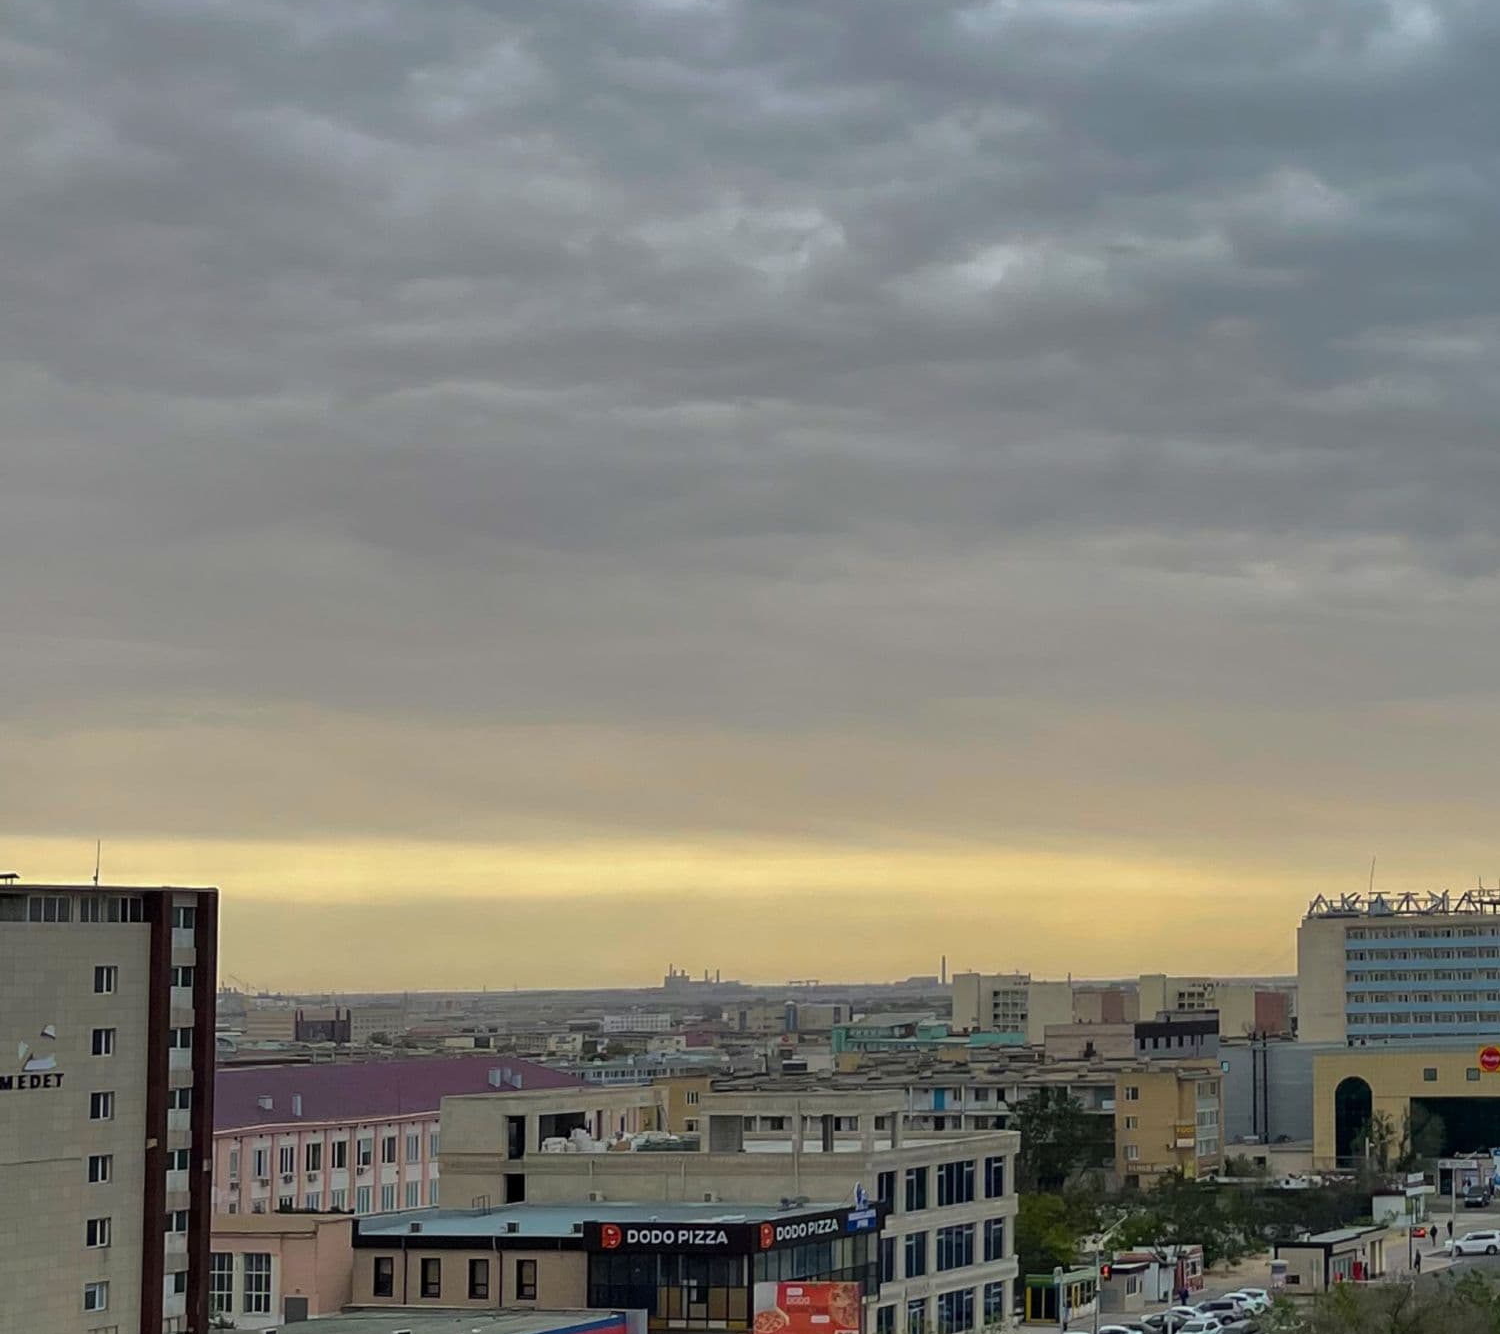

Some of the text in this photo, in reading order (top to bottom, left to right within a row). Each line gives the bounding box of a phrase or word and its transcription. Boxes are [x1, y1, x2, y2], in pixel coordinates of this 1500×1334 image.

[0, 1073, 64, 1090] MEDET
[627, 1230, 729, 1244] DODO PIZZA
[776, 1223, 807, 1241] DODO
[808, 1218, 839, 1236] PIZZA
